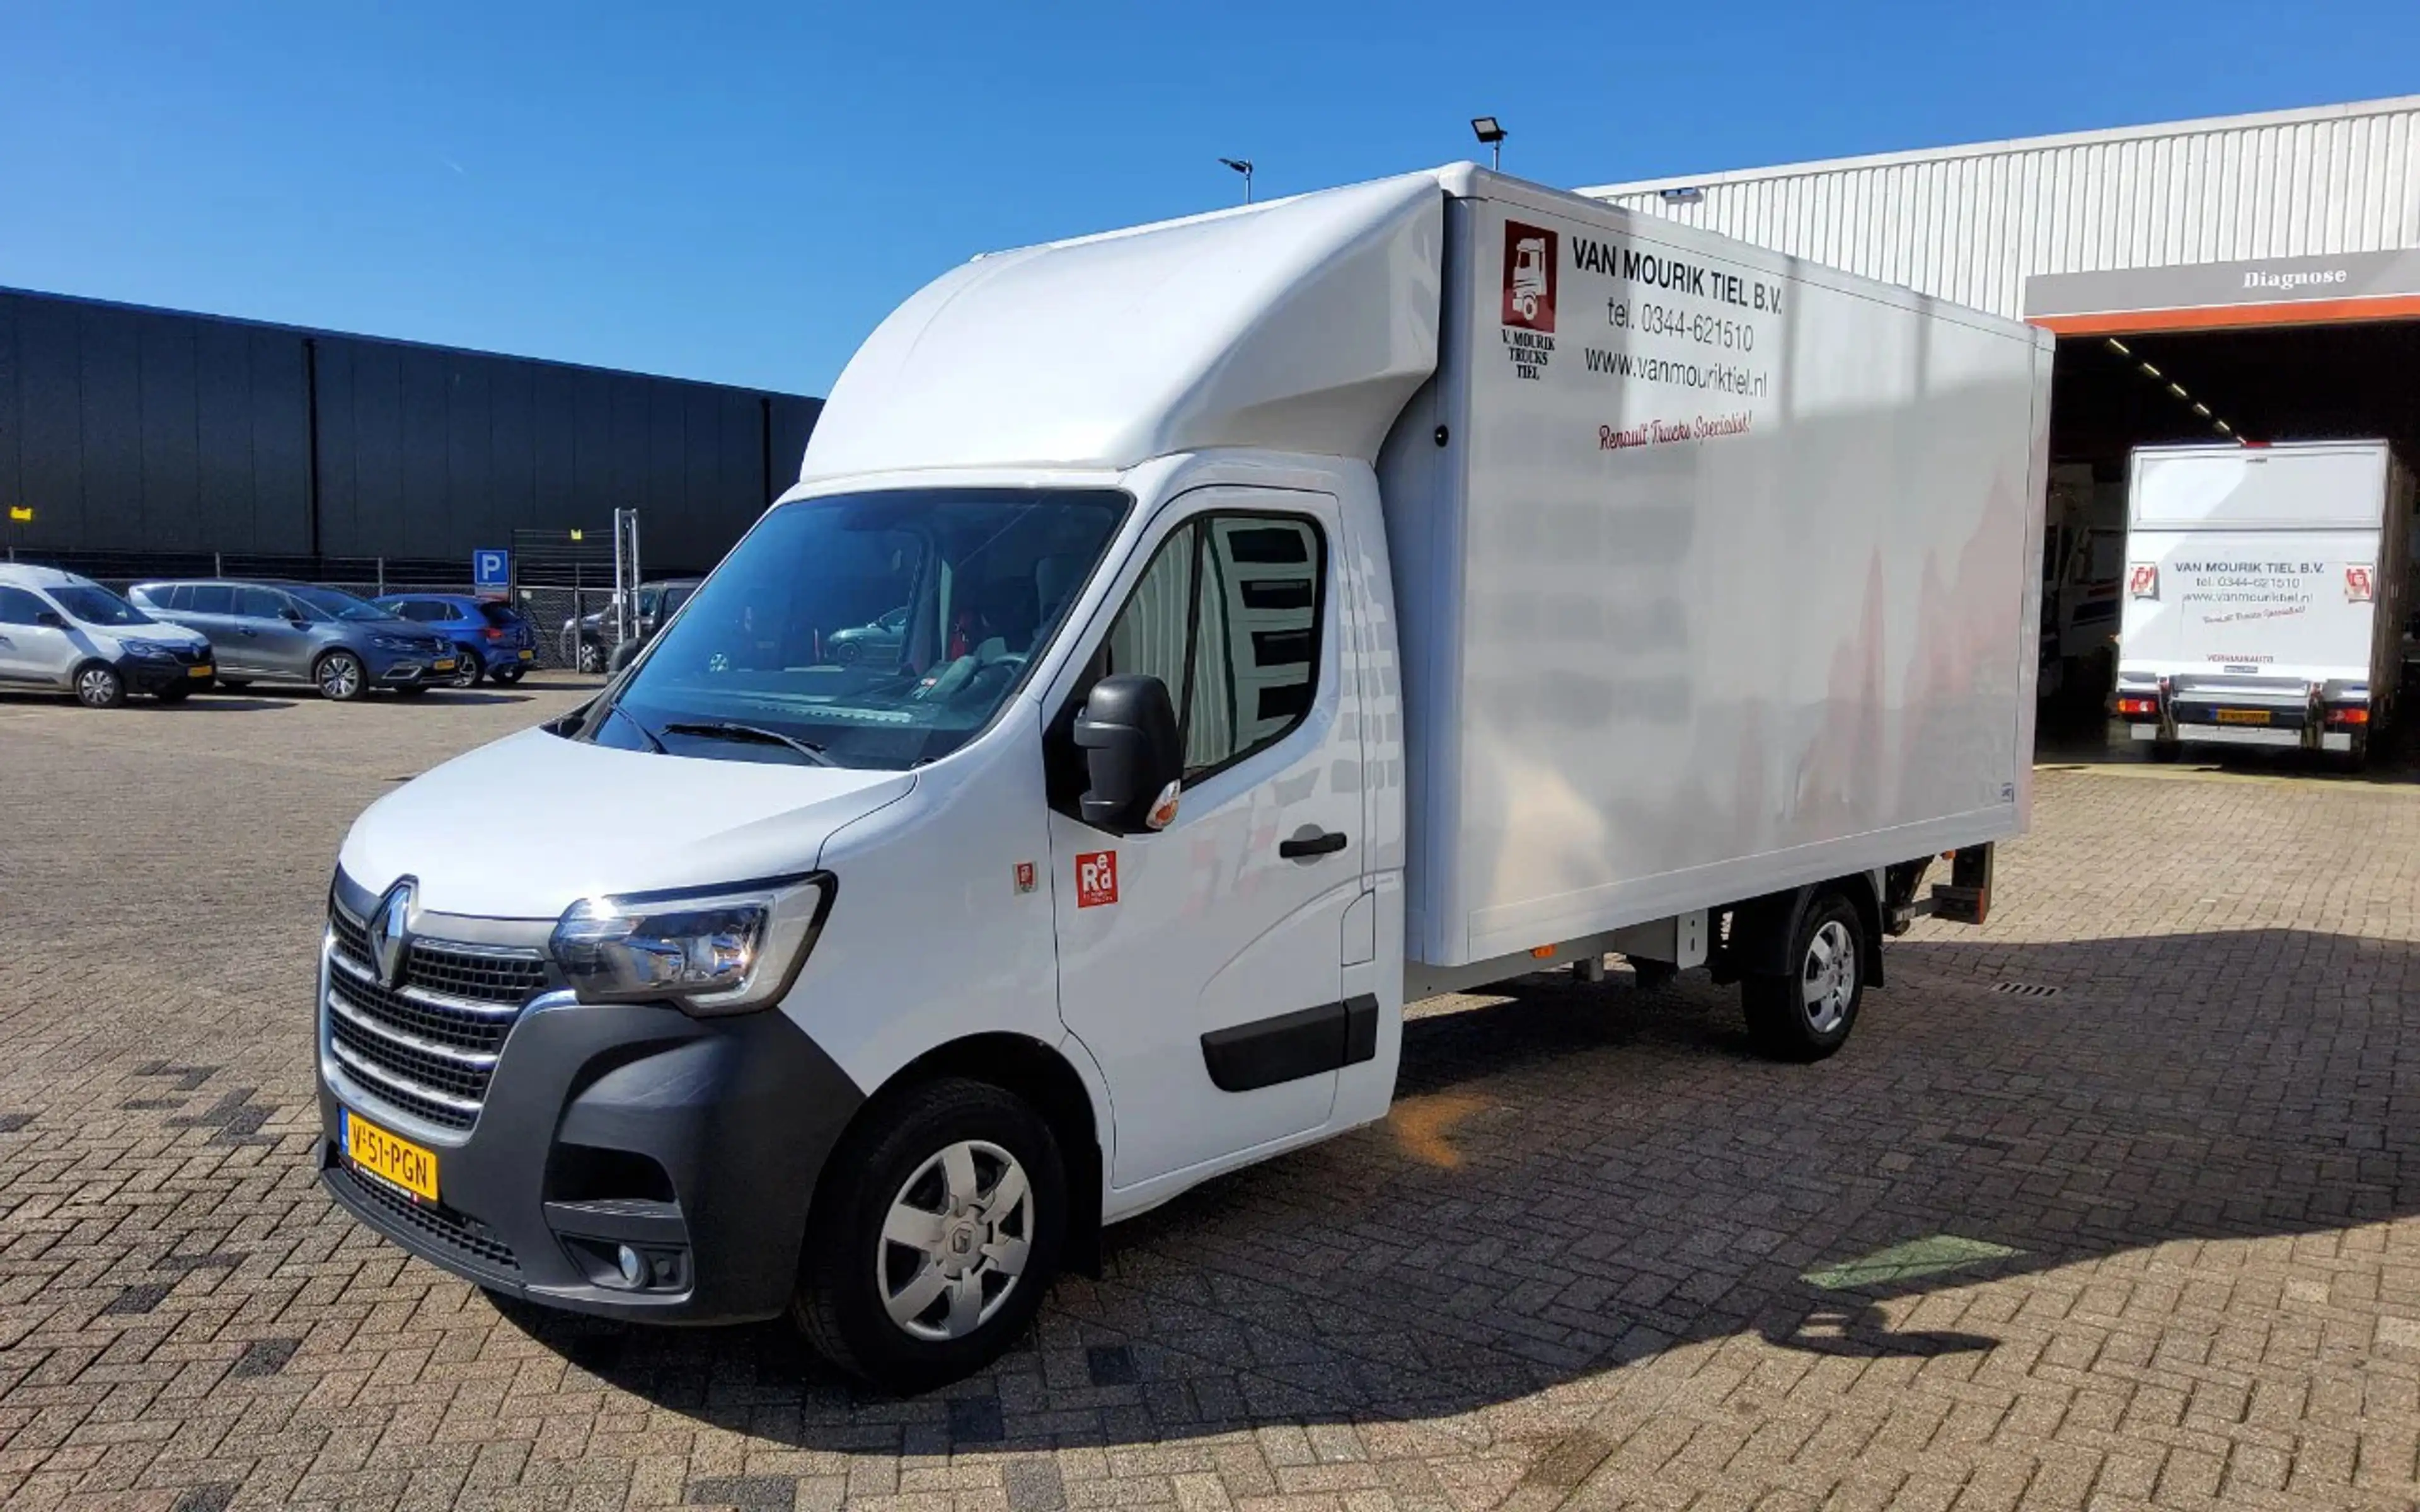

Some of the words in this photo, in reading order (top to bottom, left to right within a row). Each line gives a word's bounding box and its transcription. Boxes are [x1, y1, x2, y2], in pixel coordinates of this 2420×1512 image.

[1573, 236, 1616, 277] VAN
[1623, 249, 1705, 297] MOURIK
[1711, 270, 1748, 307] TIEL
[1754, 282, 1782, 314] B.V.
[2242, 270, 2348, 290] Diagnose
[1607, 297, 1635, 329] tel.
[1641, 304, 1754, 352] 0344-621510
[1512, 331, 1555, 351] MOURIK
[1509, 346, 1548, 365] TRUCKS
[1516, 365, 1540, 381] TIEL
[1585, 348, 1767, 398] www.vanmouriktiel.nl
[1599, 423, 1648, 450] Renault
[1650, 419, 1690, 445] Trucks
[1693, 410, 1753, 446] Specialist!
[481, 554, 501, 580] P
[2175, 562, 2202, 573] VAN
[2206, 562, 2262, 573] MOURIK
[2266, 563, 2296, 574] TIEL
[2300, 563, 2325, 574] B.V.
[2196, 576, 2214, 587] tel.
[2217, 576, 2300, 588] 0344-621510
[353, 1123, 427, 1189] V-51-PGN
